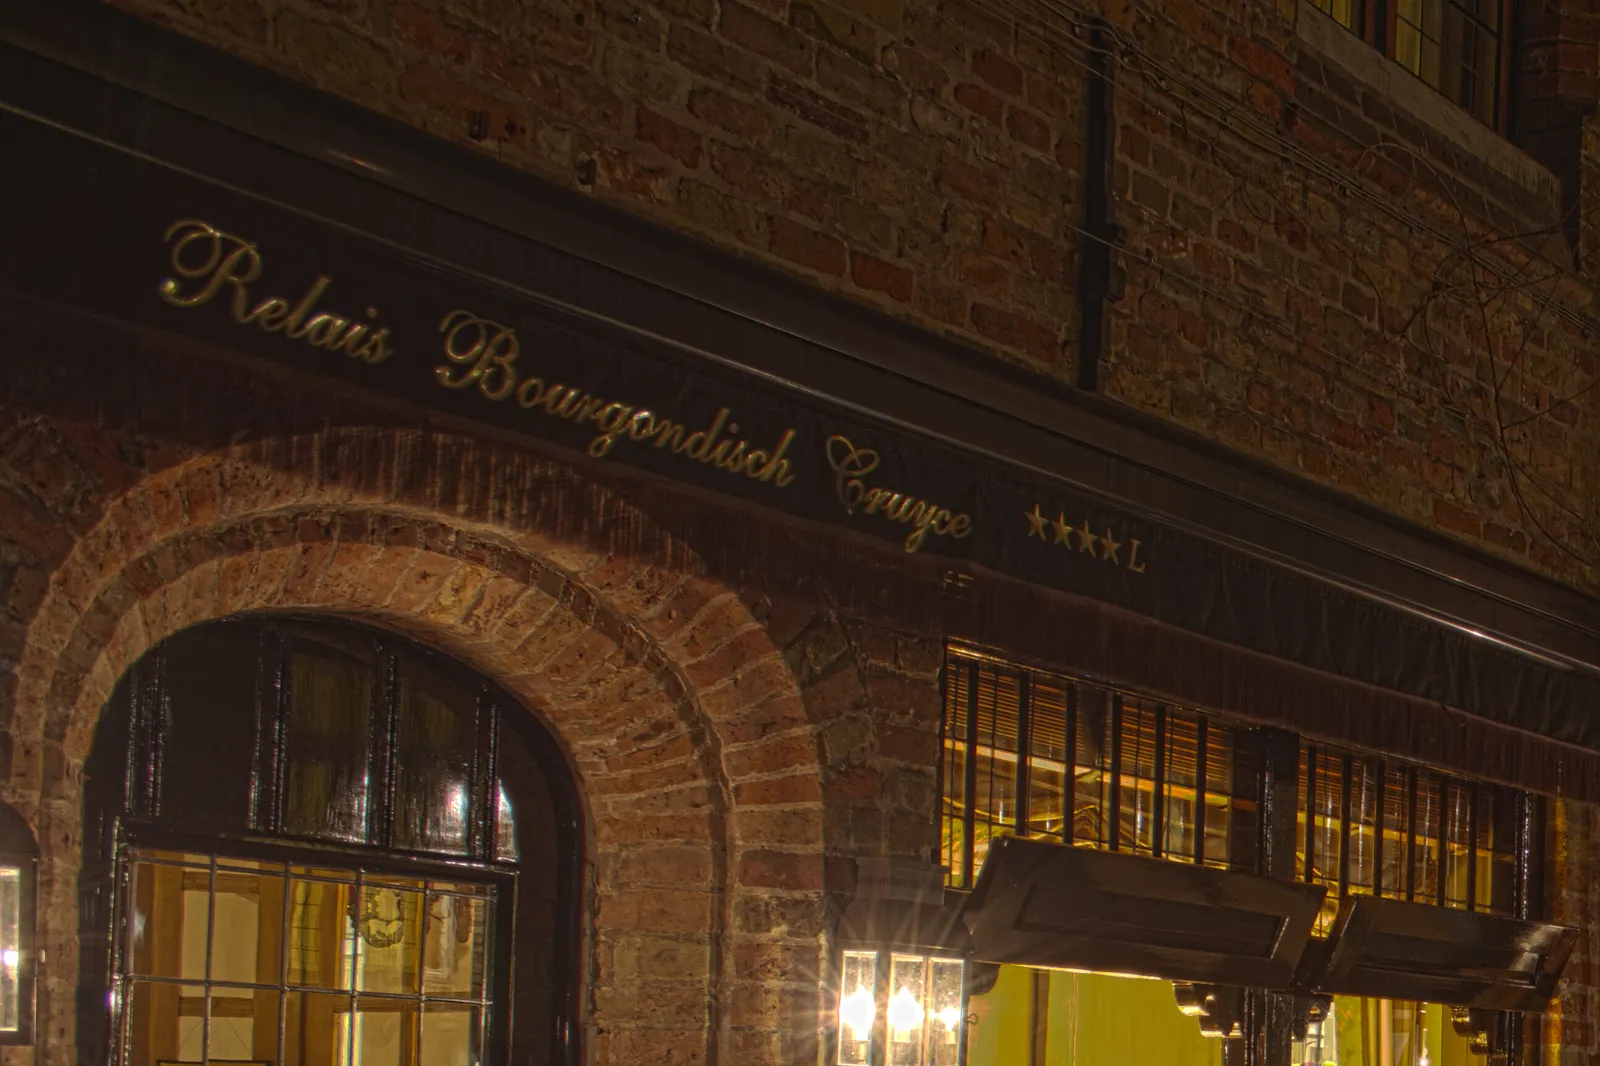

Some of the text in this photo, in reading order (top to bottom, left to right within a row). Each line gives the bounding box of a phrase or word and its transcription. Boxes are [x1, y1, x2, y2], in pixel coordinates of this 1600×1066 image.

[158, 218, 395, 365] Relais
[433, 309, 797, 488] Bourgondisch
[826, 434, 973, 554] Cruyce
